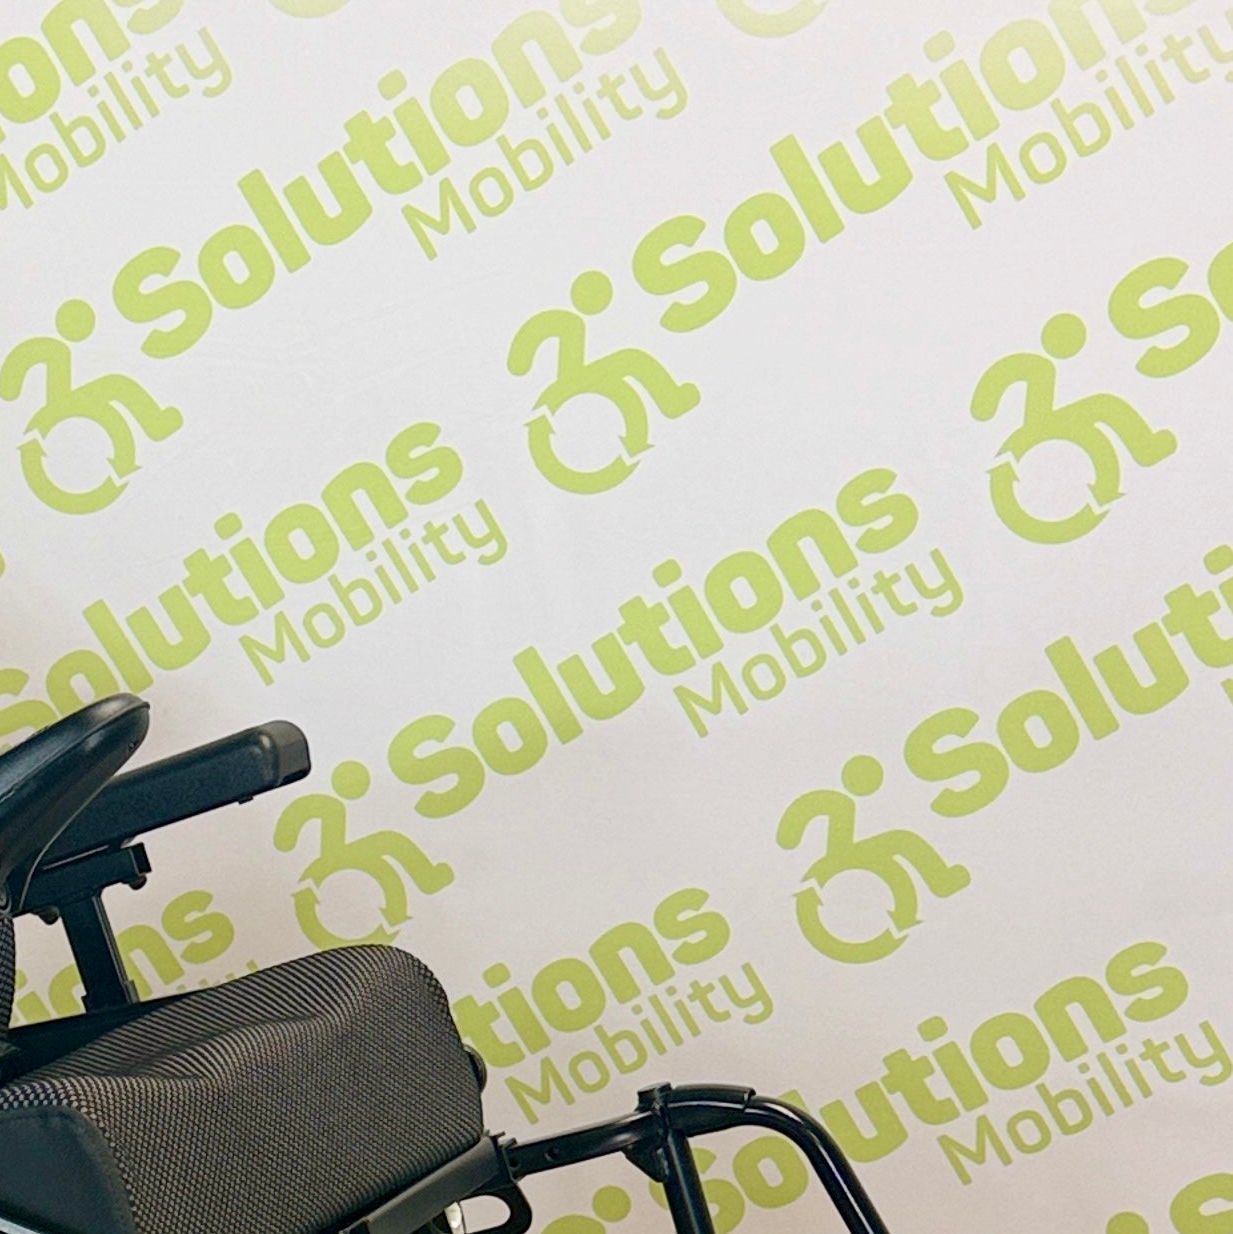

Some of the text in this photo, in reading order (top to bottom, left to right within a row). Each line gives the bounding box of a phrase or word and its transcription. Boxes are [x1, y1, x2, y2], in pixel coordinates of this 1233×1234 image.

[402, 47, 688, 259] Mobility
[240, 499, 509, 685] Mobility
[387, 467, 920, 819] Solutions
[674, 548, 965, 737] Mobility
[504, 962, 774, 1125] Mobility
[936, 1020, 1232, 1186] Mobility
